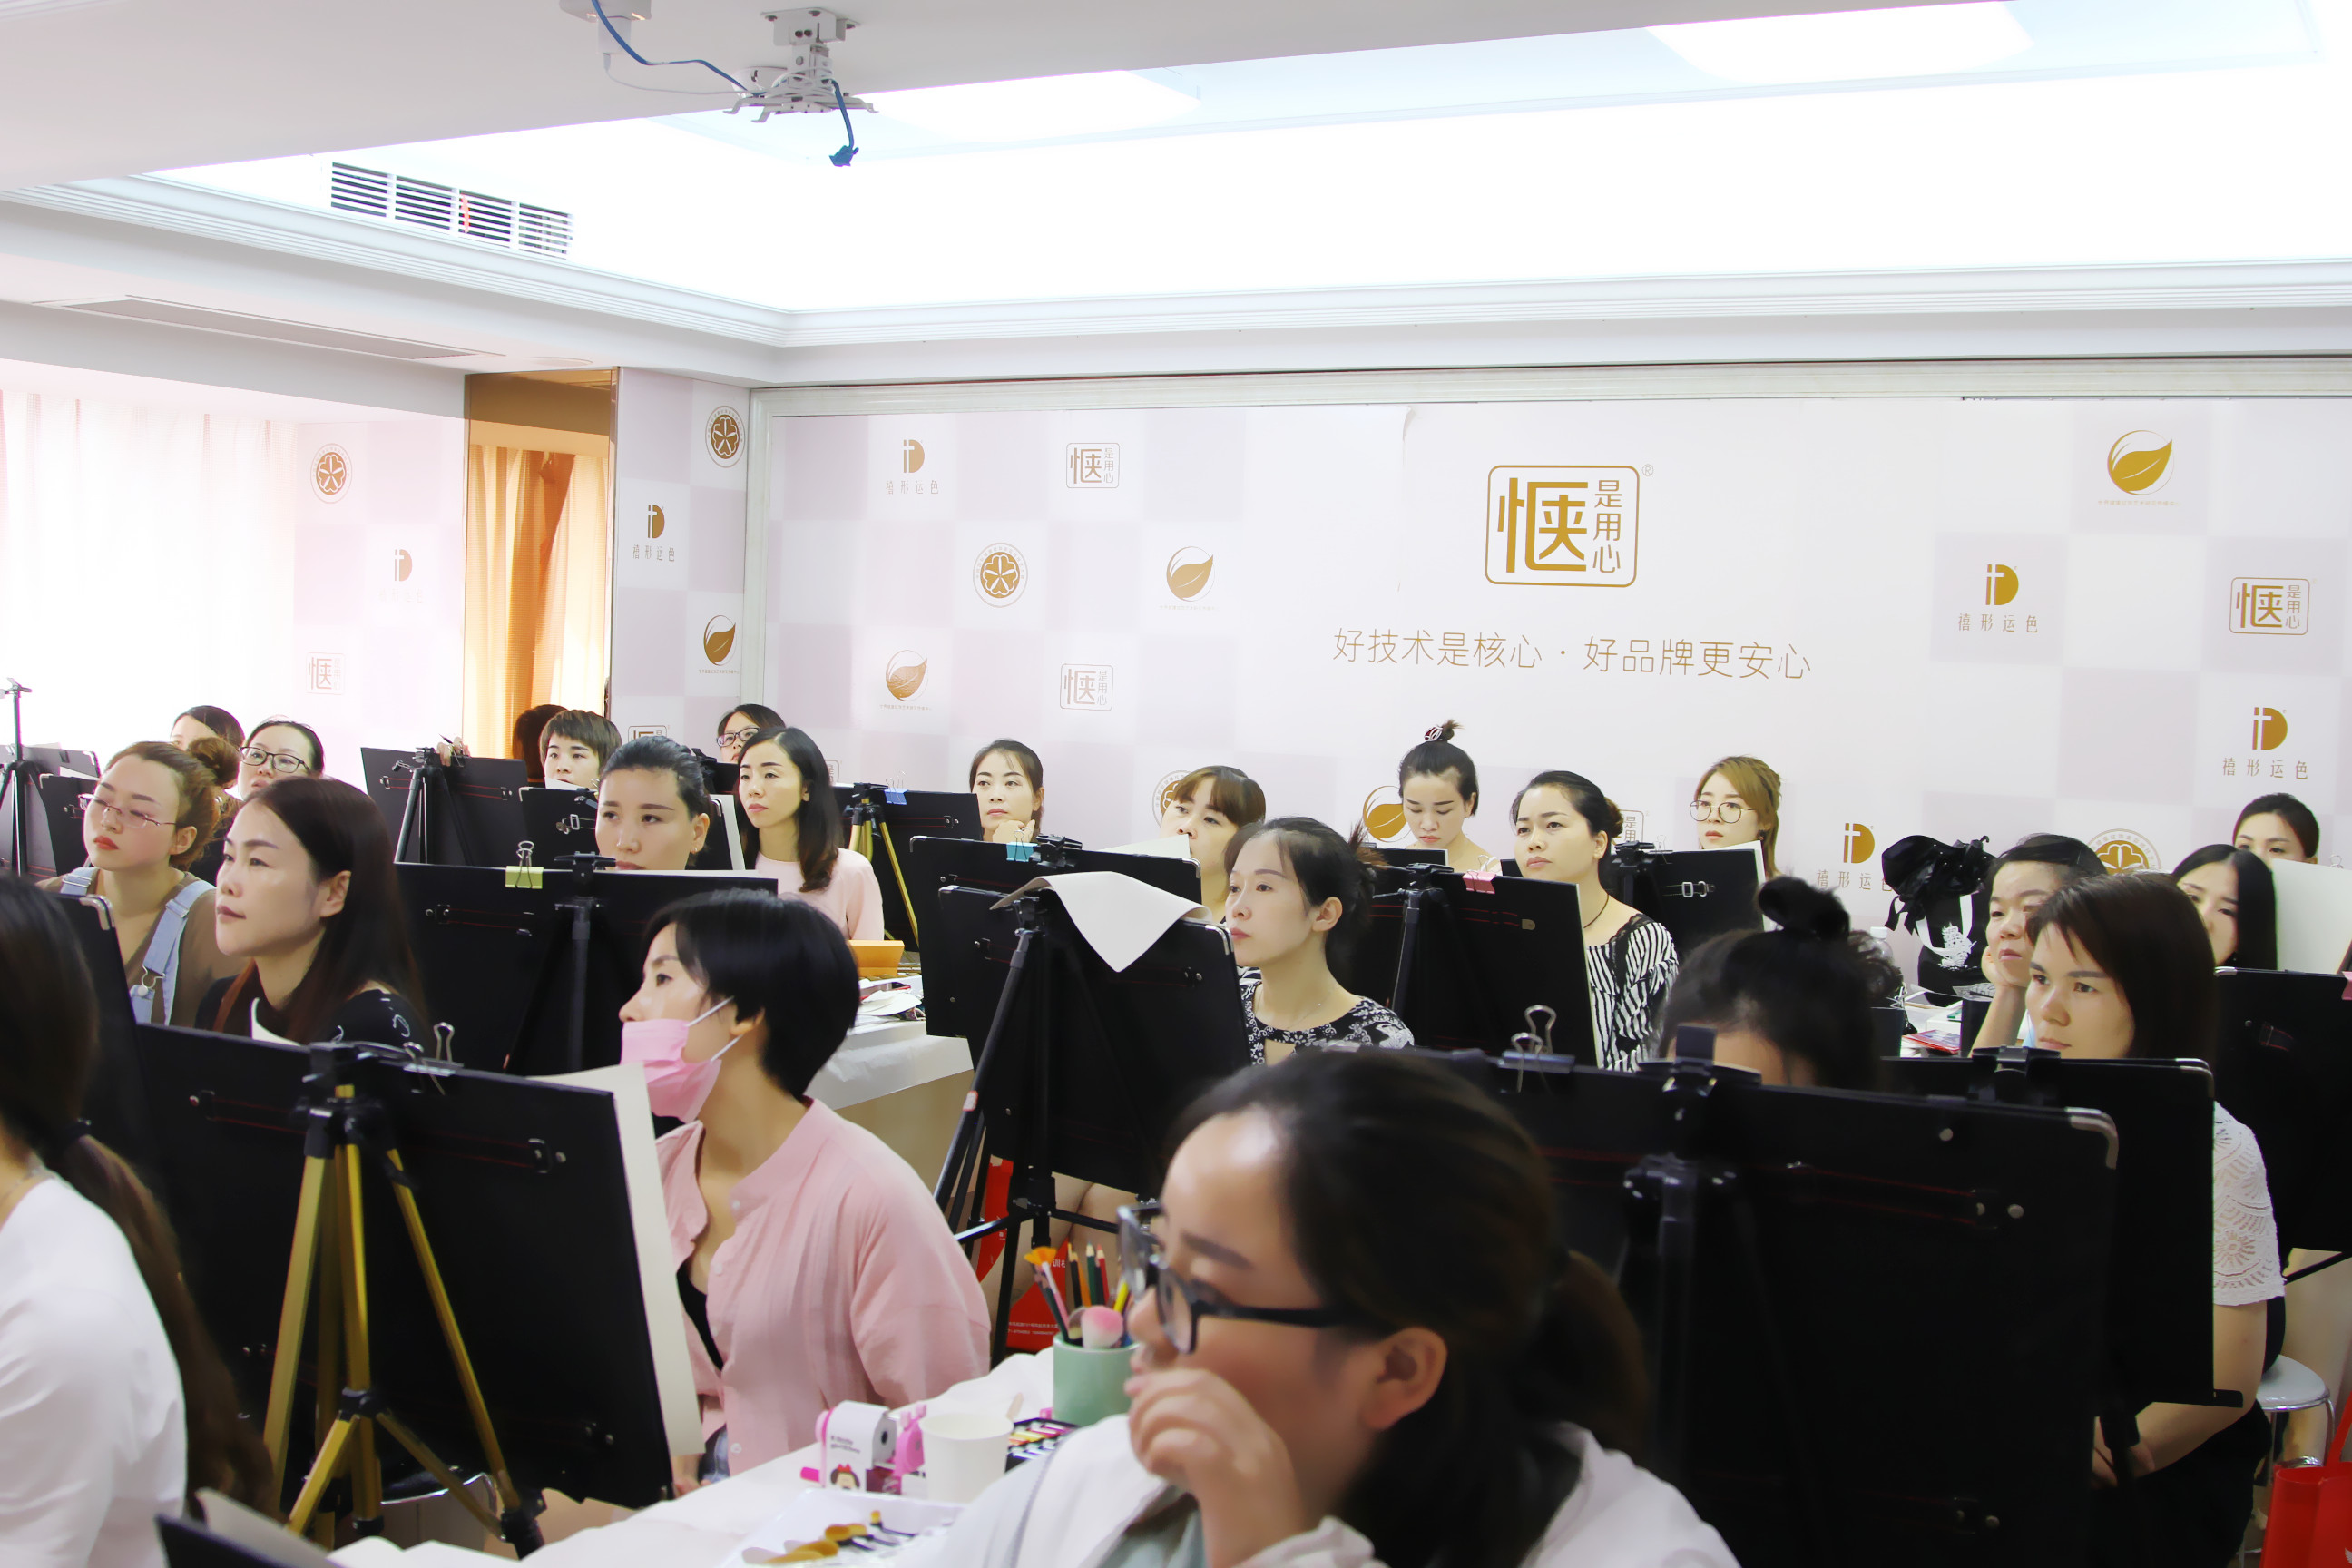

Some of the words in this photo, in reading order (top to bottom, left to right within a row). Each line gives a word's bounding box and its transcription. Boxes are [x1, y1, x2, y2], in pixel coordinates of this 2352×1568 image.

[1497, 477, 1588, 573] 惬
[1592, 480, 1622, 573] 是用心
[1958, 612, 2038, 633] 禧形运色
[2236, 583, 2284, 629] 惬
[2285, 584, 2301, 630] 是用心
[2222, 757, 2308, 780] 禧形运色
[1624, 816, 1637, 842] 是用
